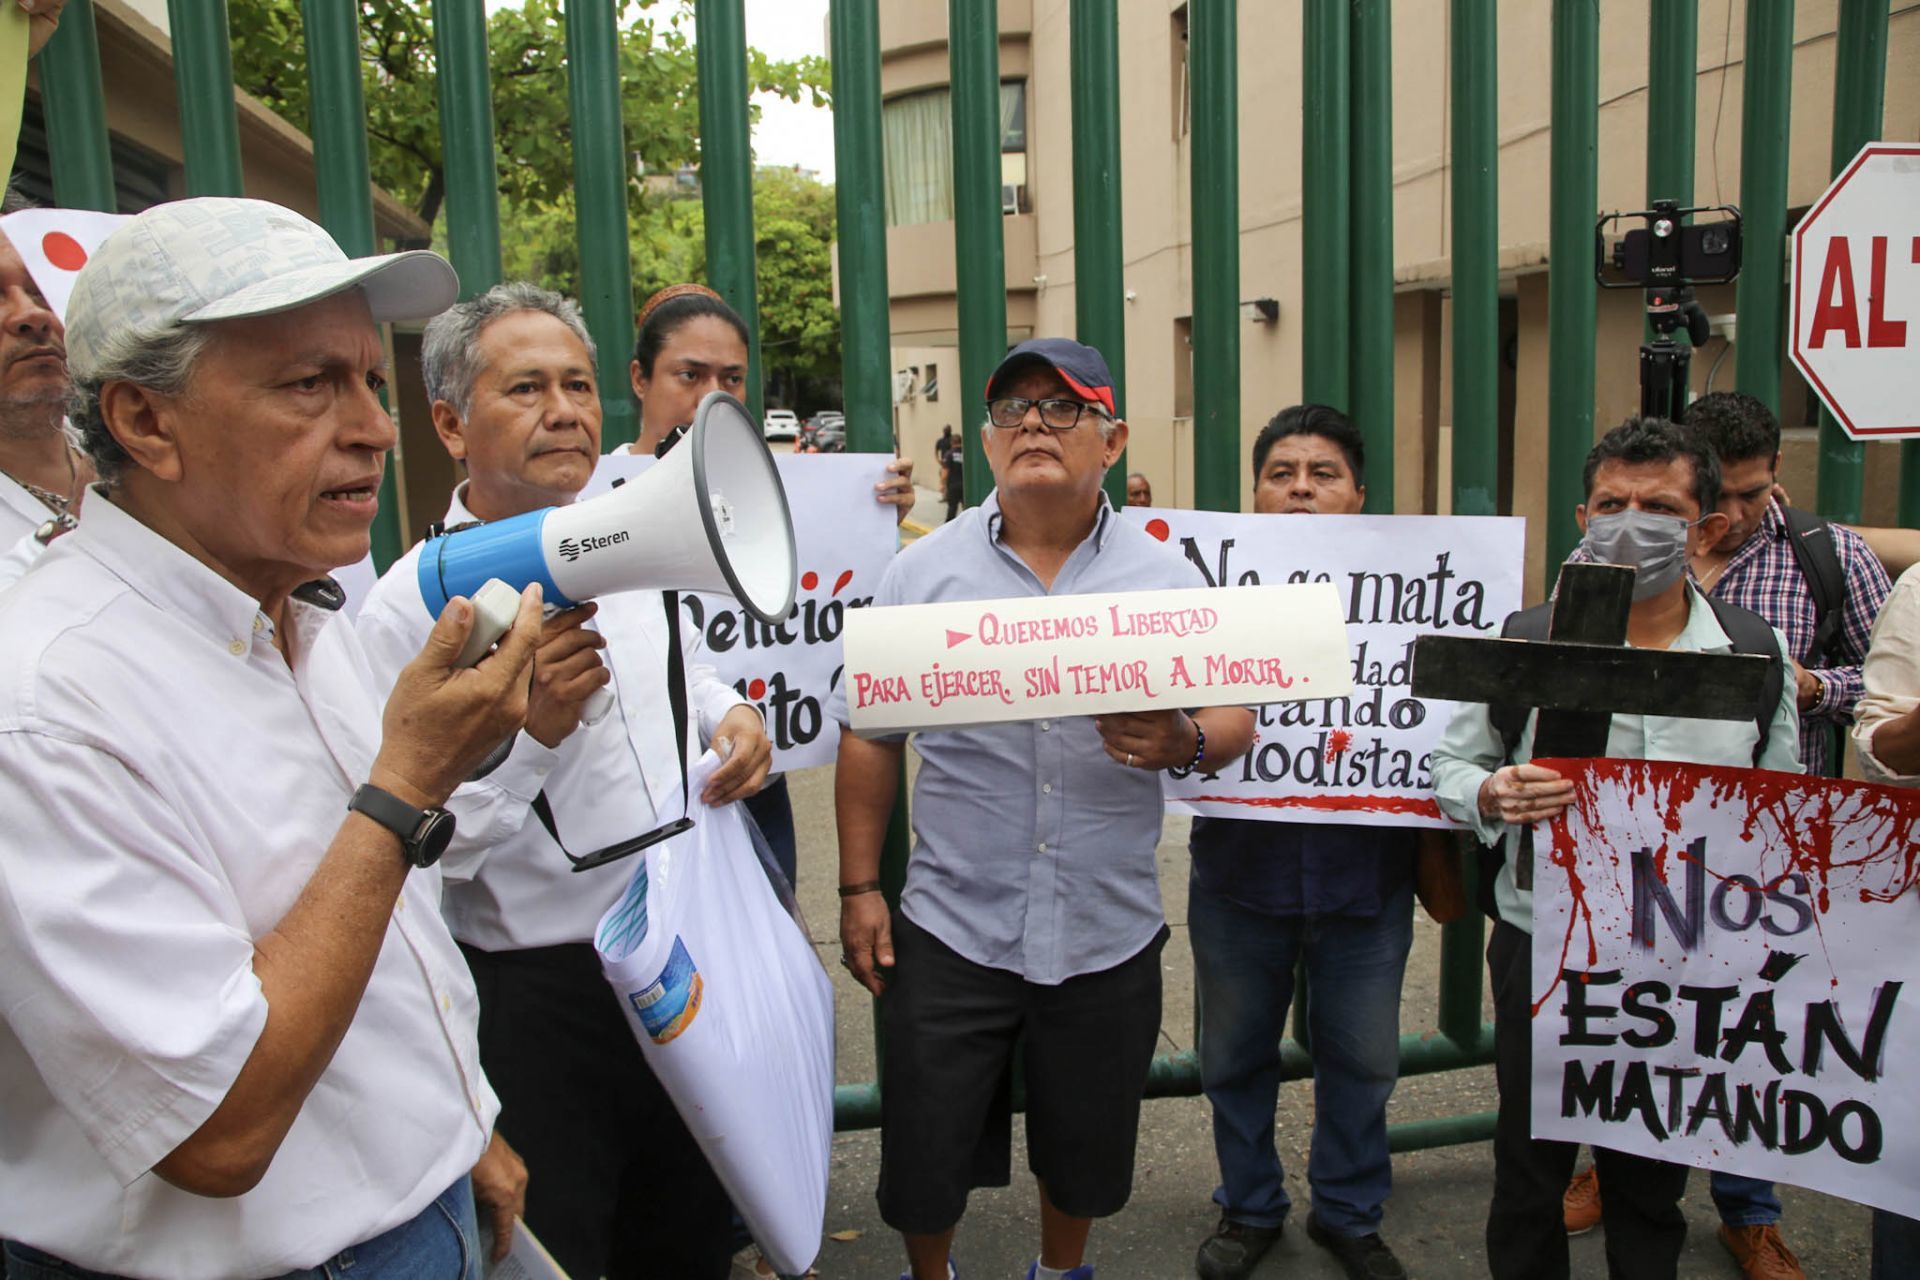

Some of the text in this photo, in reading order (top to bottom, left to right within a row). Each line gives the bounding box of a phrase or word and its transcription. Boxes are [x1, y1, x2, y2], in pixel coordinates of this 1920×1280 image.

[1807, 236, 1920, 349] AL
[581, 530, 629, 553] Steren
[978, 604, 1218, 646] QUEREMOS LIBERTAD
[1345, 551, 1495, 630] mata
[853, 672, 912, 709] PARA
[1024, 655, 1061, 698] SIN
[1067, 660, 1160, 697] TEMOR
[1170, 656, 1196, 689] A
[1558, 950, 1904, 1083] ESTÁN
[1561, 1059, 1883, 1165] MATANDO
